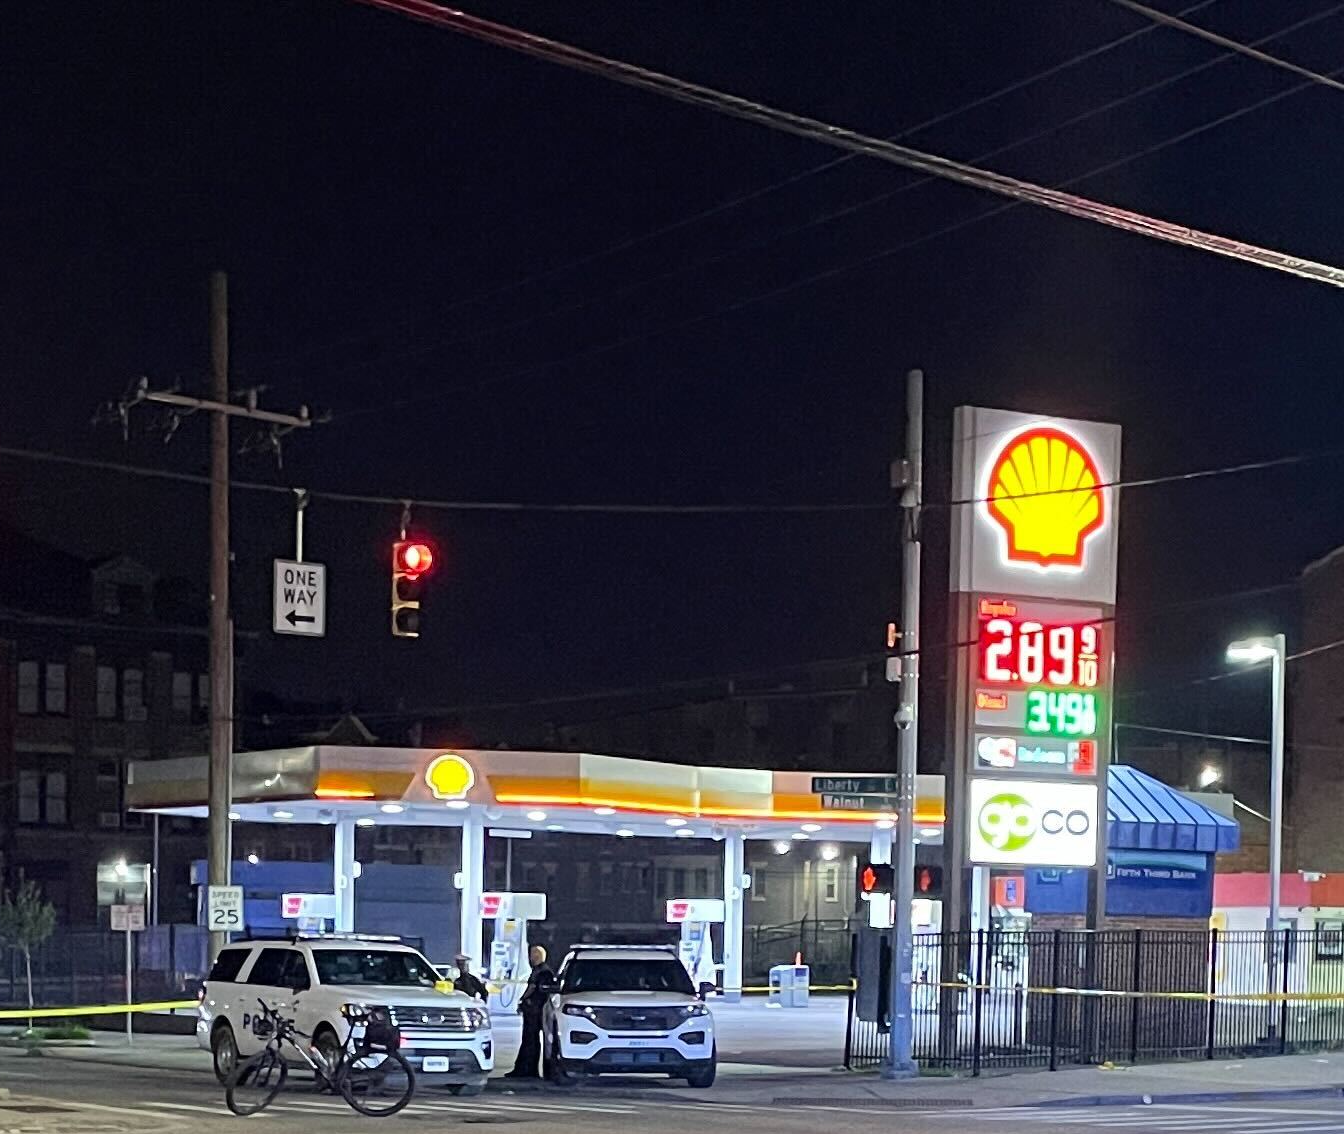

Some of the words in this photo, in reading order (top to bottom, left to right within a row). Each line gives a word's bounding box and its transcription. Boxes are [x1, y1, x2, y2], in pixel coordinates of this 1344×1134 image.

[284, 569, 316, 587] ONE
[284, 588, 317, 605] WAY
[986, 619, 1074, 685] 2.89
[815, 778, 861, 793] Liberty
[823, 795, 865, 809] Walnut
[214, 909, 239, 924] 25
